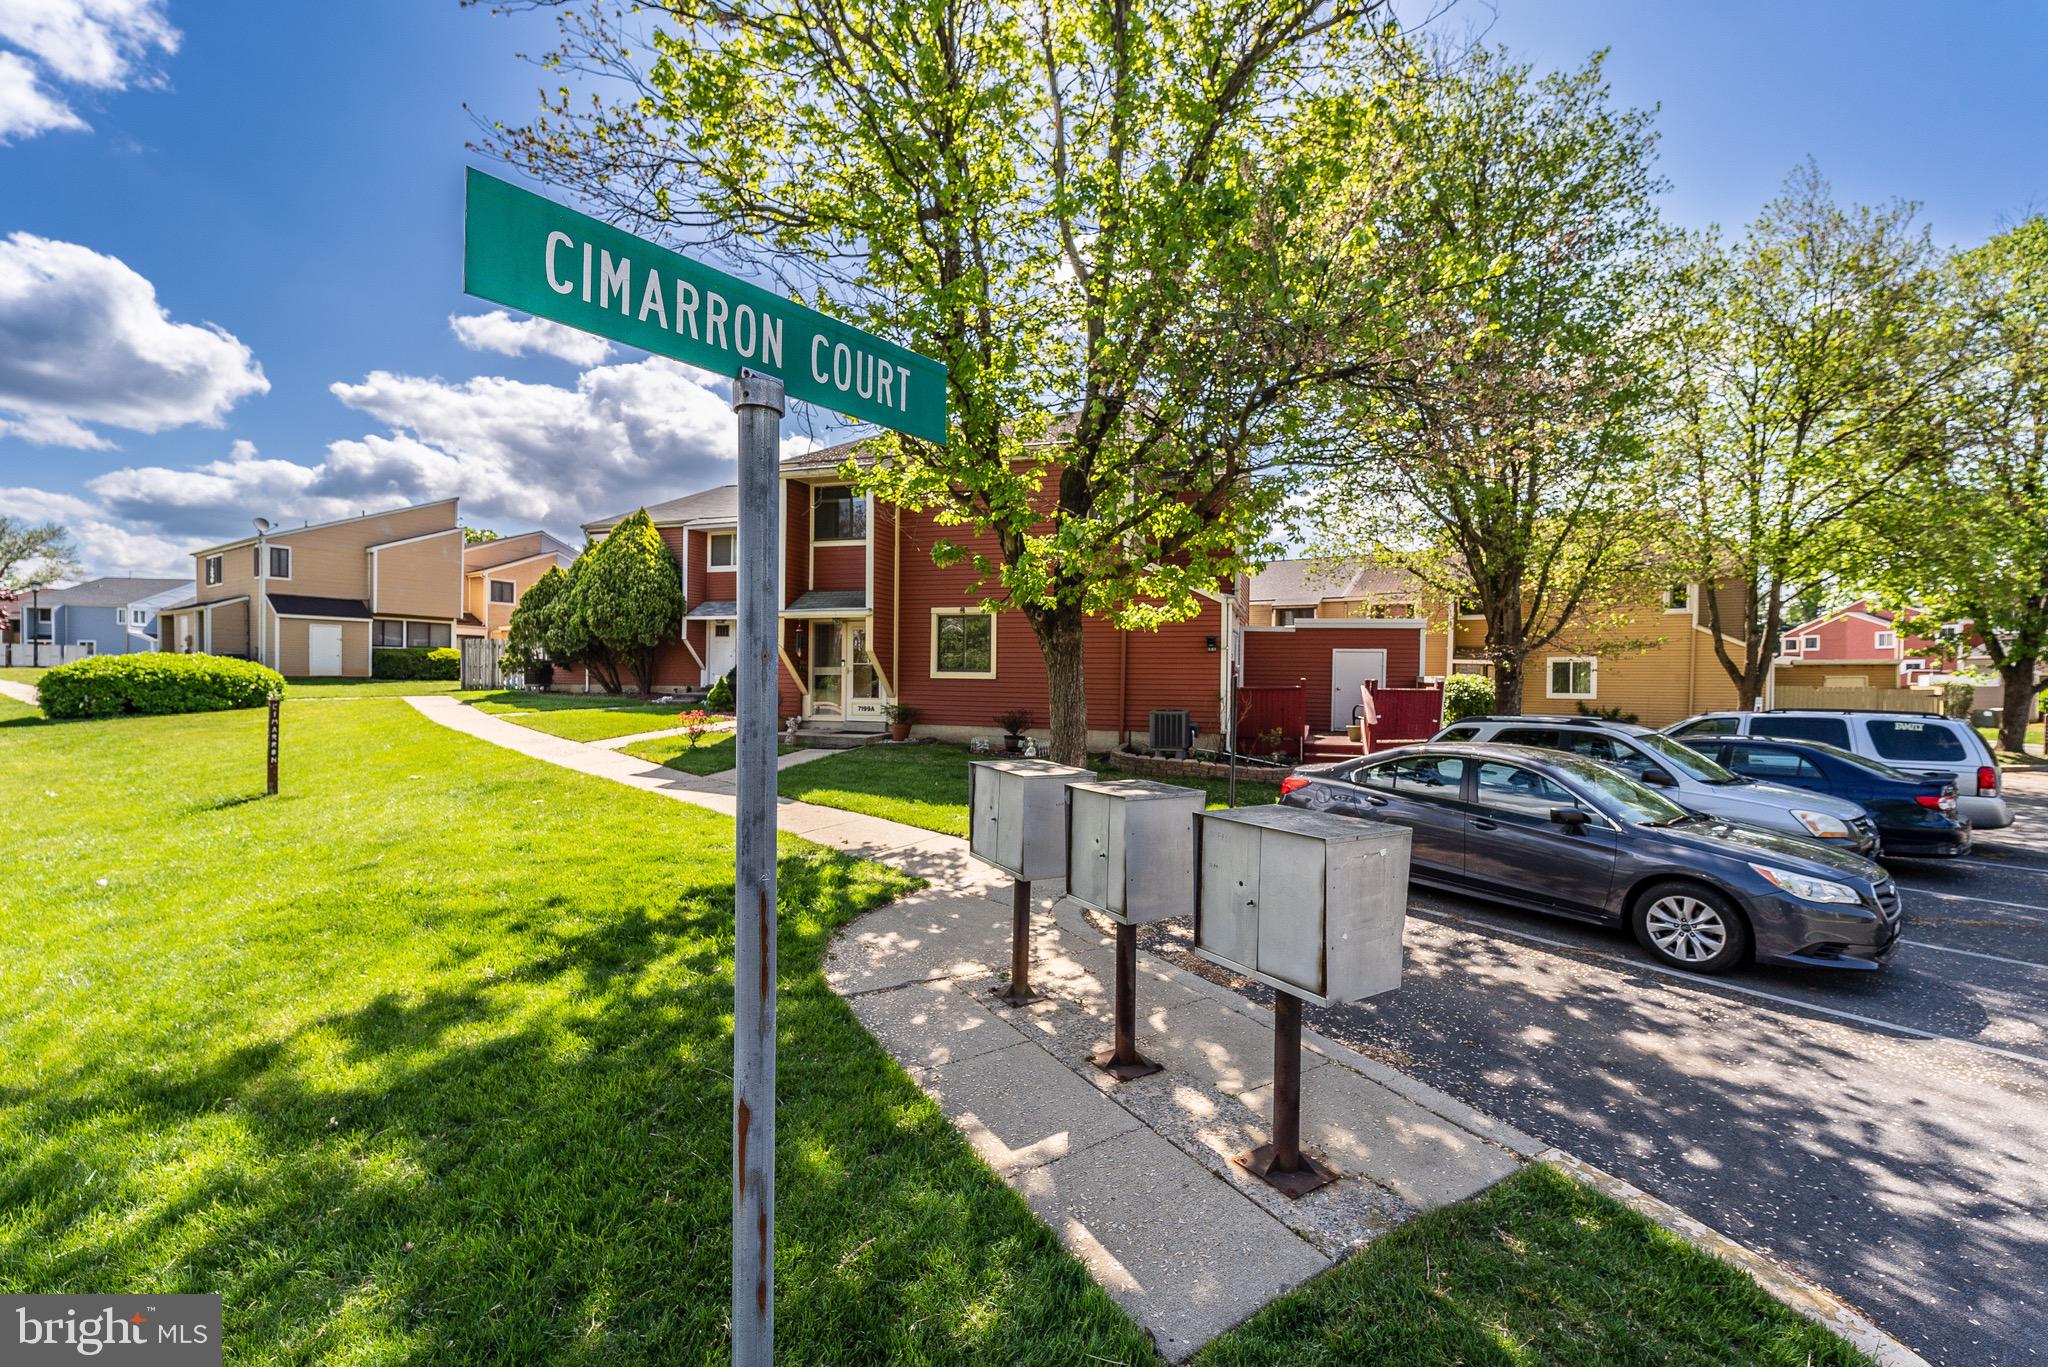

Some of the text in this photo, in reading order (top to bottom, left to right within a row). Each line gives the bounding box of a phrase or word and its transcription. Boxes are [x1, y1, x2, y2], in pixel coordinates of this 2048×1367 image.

[546, 230, 910, 411] CIMARRON COURT
[270, 703, 279, 764] CIMARRON
